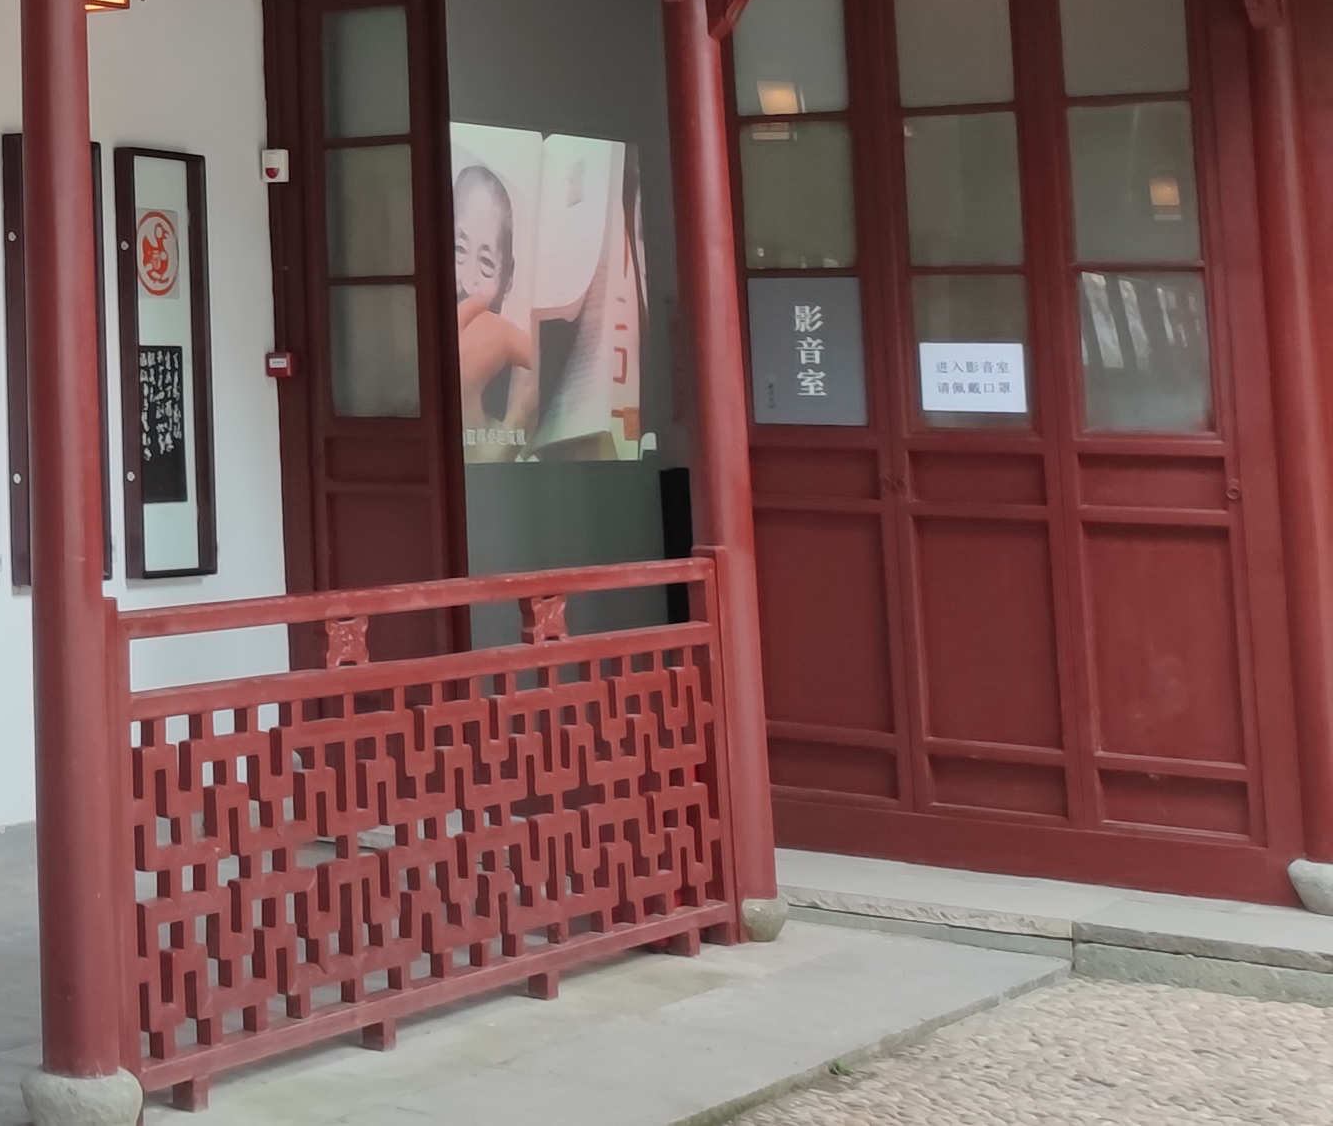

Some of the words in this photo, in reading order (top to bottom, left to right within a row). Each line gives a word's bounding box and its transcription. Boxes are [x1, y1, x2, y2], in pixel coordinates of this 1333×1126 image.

[794, 305, 827, 397] 影音室
[935, 360, 1011, 374] 进入影音室
[937, 381, 1012, 395] 请佩戴口罩
[463, 427, 528, 447] 取得卓越成就
